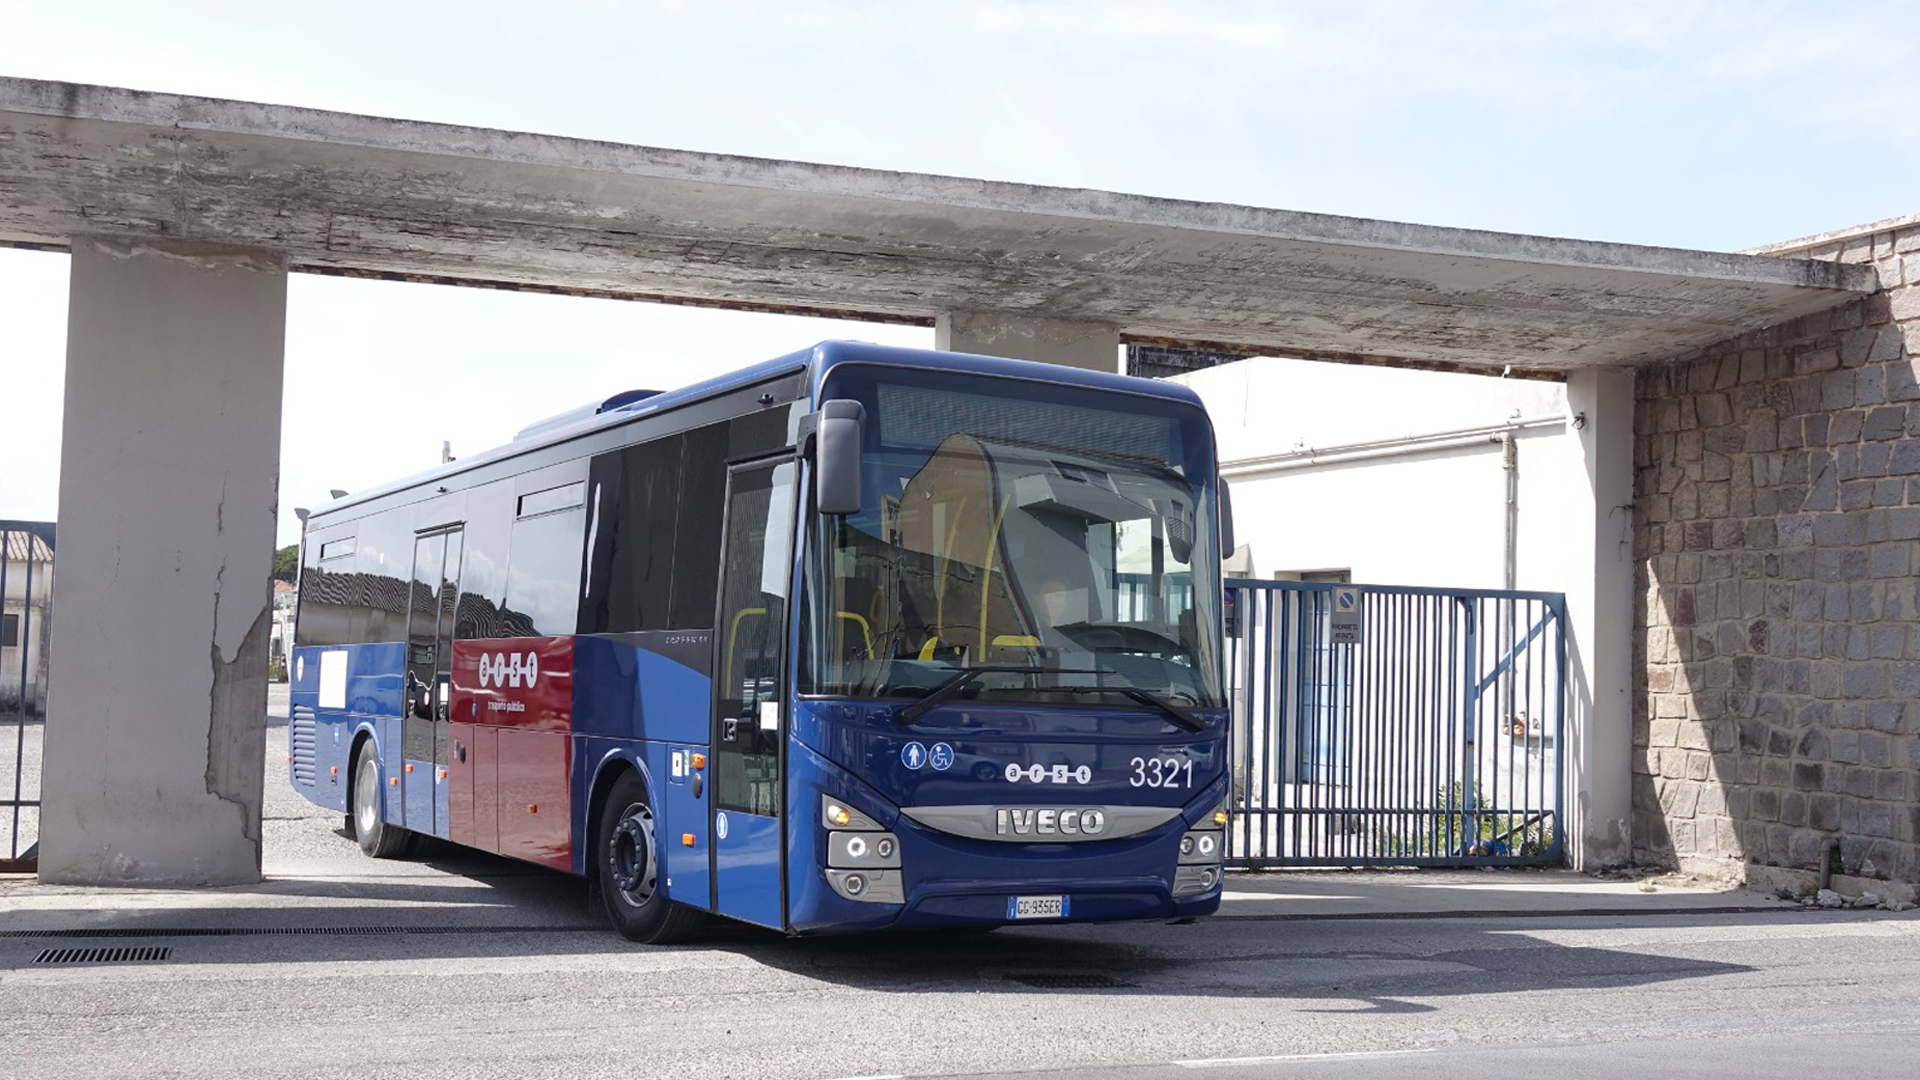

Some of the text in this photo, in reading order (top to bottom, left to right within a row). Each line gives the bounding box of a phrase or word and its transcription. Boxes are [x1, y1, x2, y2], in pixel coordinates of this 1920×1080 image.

[480, 654, 536, 685] arst
[1006, 763, 1090, 783] arst
[1129, 757, 1193, 788] 3321
[996, 809, 1104, 834] IVECO
